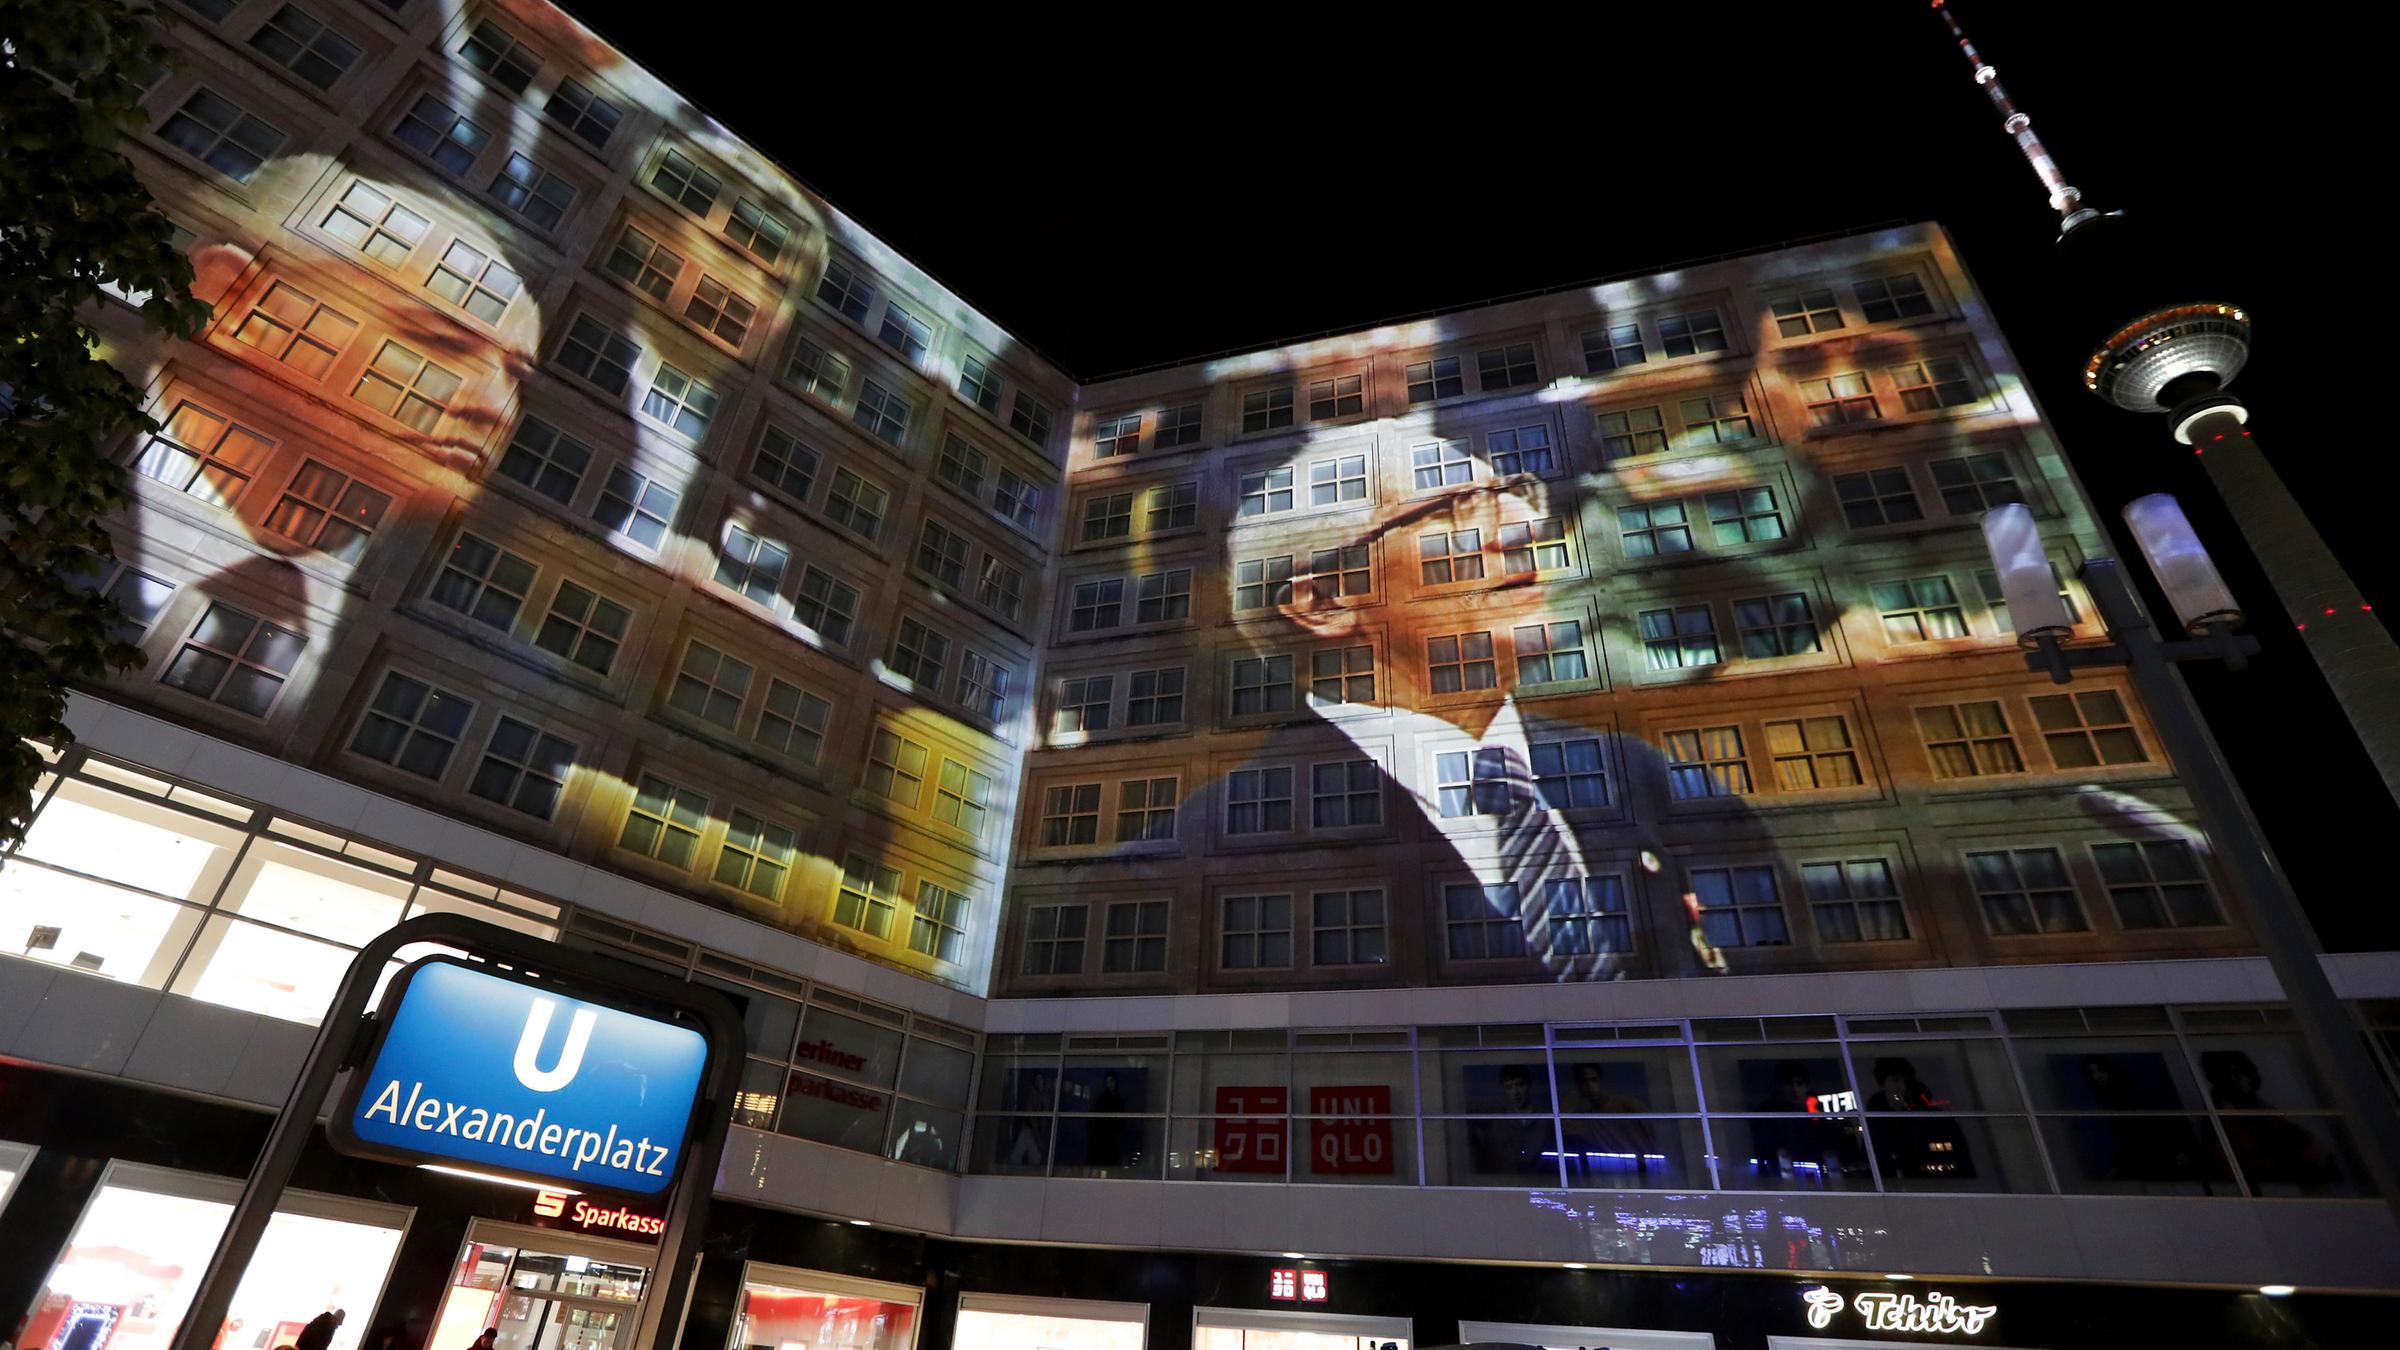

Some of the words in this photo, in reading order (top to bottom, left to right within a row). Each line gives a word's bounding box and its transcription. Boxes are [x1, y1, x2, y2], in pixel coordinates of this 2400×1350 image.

[513, 997, 598, 1093] U
[796, 1040, 867, 1072] erliner
[364, 1080, 670, 1177] Alexanderplatz
[1319, 1097, 1377, 1127] UNI
[1319, 1132, 1383, 1169] QLO
[1854, 1291, 1997, 1335] Tchibo
